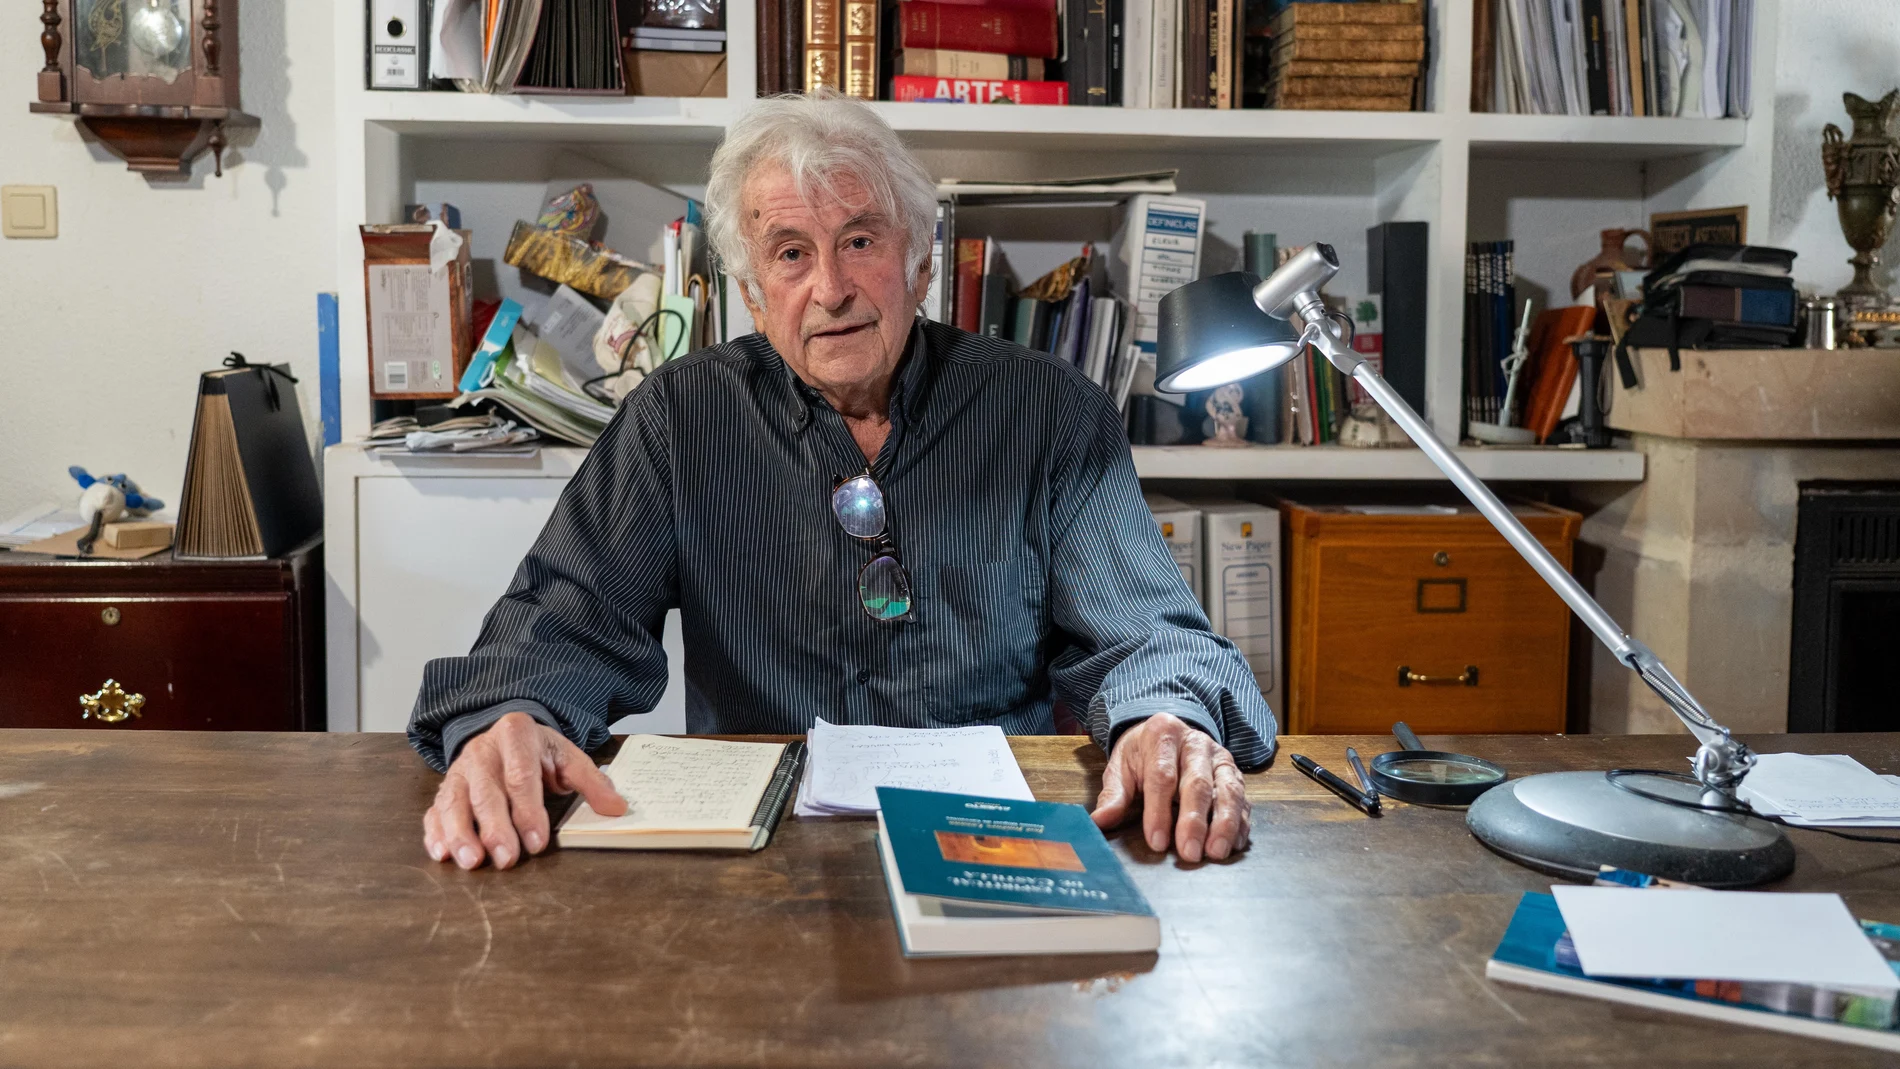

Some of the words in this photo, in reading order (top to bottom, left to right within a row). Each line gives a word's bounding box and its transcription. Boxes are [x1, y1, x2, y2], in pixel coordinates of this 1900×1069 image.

[934, 79, 1004, 104] ARTE
[1221, 542, 1242, 551] New
[1246, 540, 1271, 552] Paper
